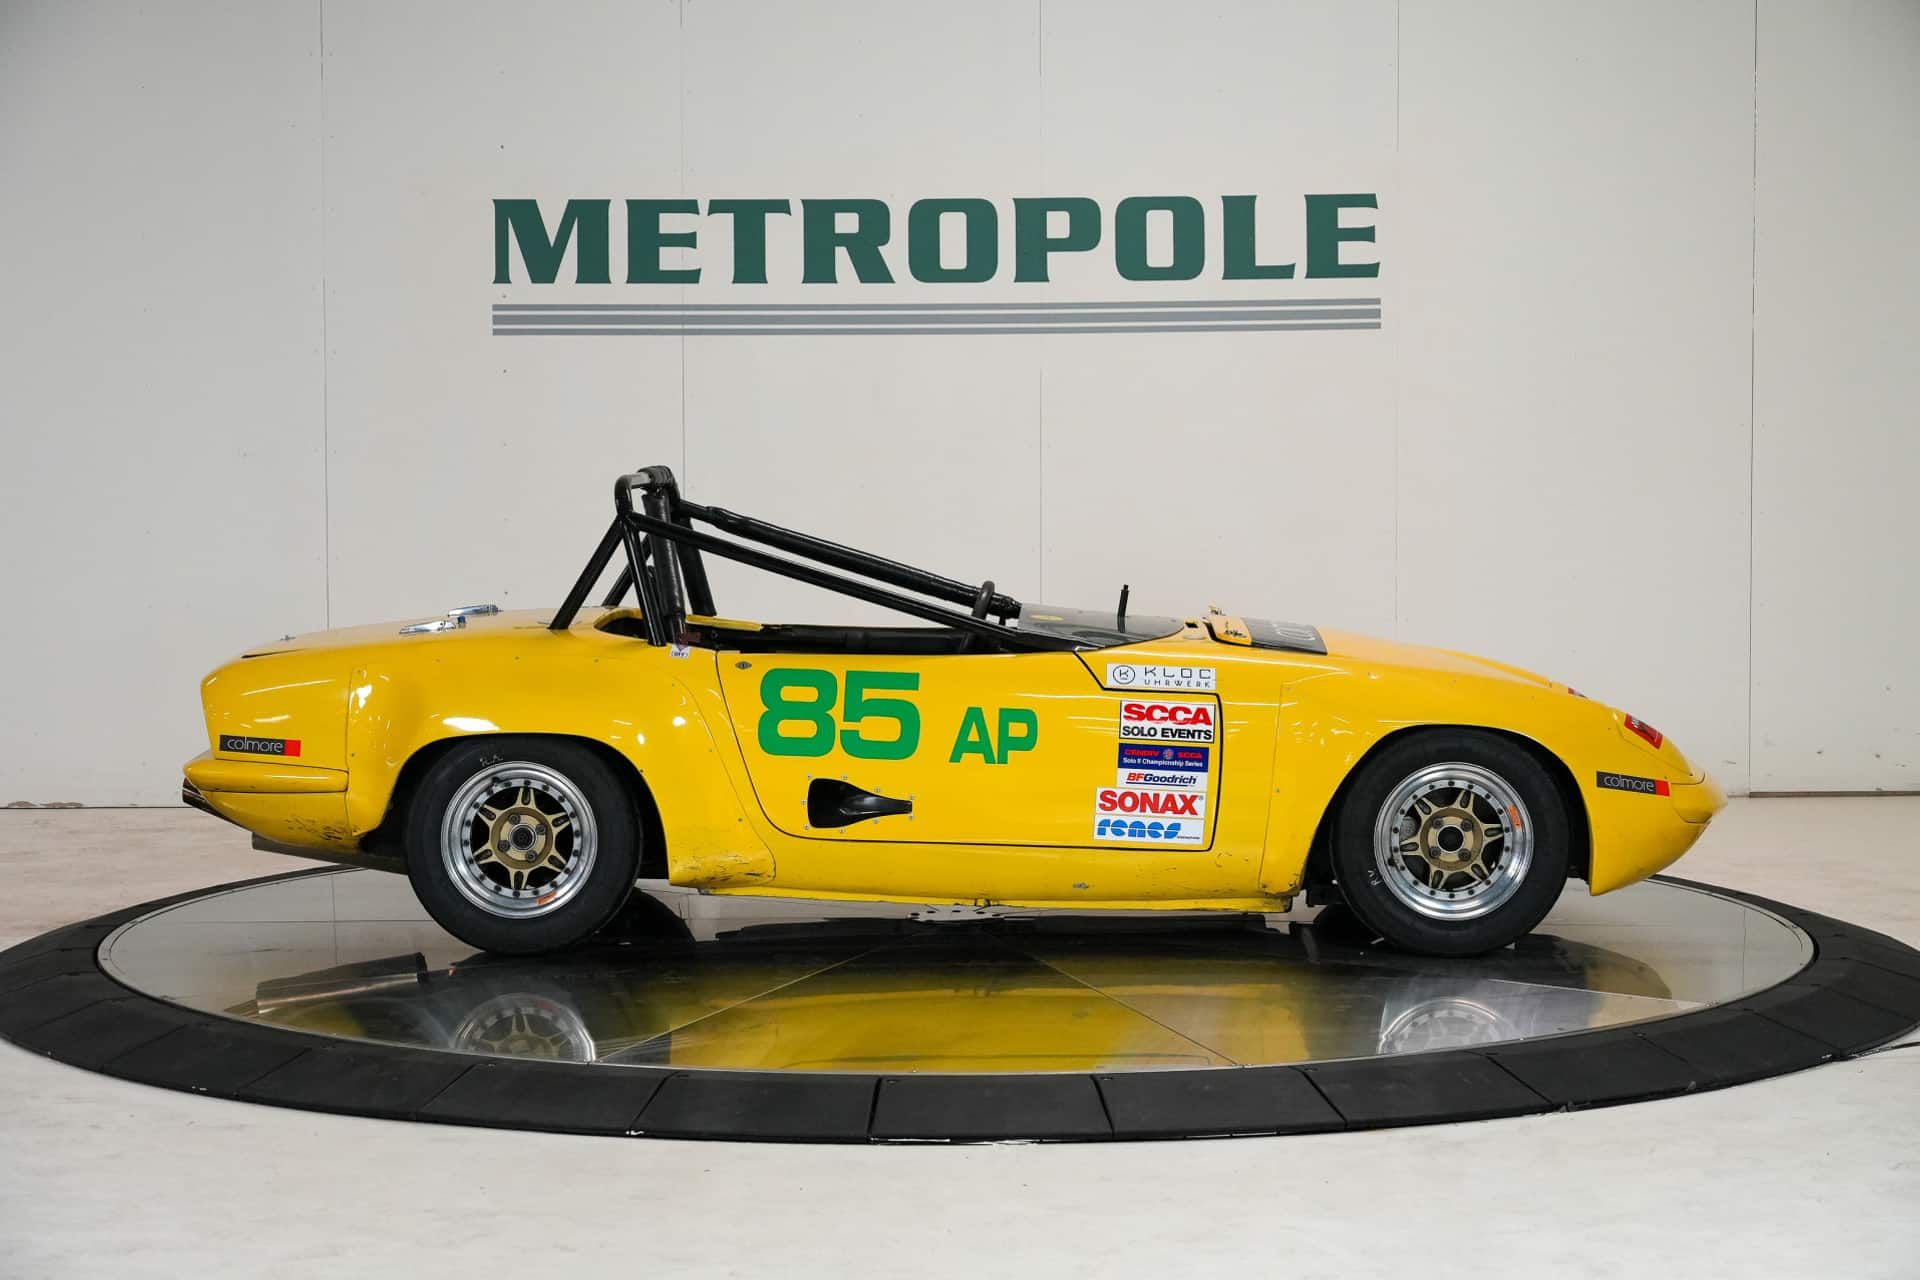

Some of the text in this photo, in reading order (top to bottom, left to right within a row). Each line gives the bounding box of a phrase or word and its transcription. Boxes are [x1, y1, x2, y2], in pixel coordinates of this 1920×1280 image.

[492, 193, 1381, 284] METROPOLE
[1144, 666, 1212, 679] KLOC
[1144, 679, 1211, 688] UHRWERK
[758, 668, 920, 760] 85
[1123, 703, 1213, 726] SCCA
[949, 707, 1038, 764] AP
[1122, 726, 1212, 740] SOLO EVENTS
[227, 736, 284, 753] colmore
[1143, 759, 1184, 767] Championship
[1127, 772, 1197, 785] BFGoodrich
[1604, 776, 1655, 792] colmore
[1099, 790, 1198, 816] SONAX
